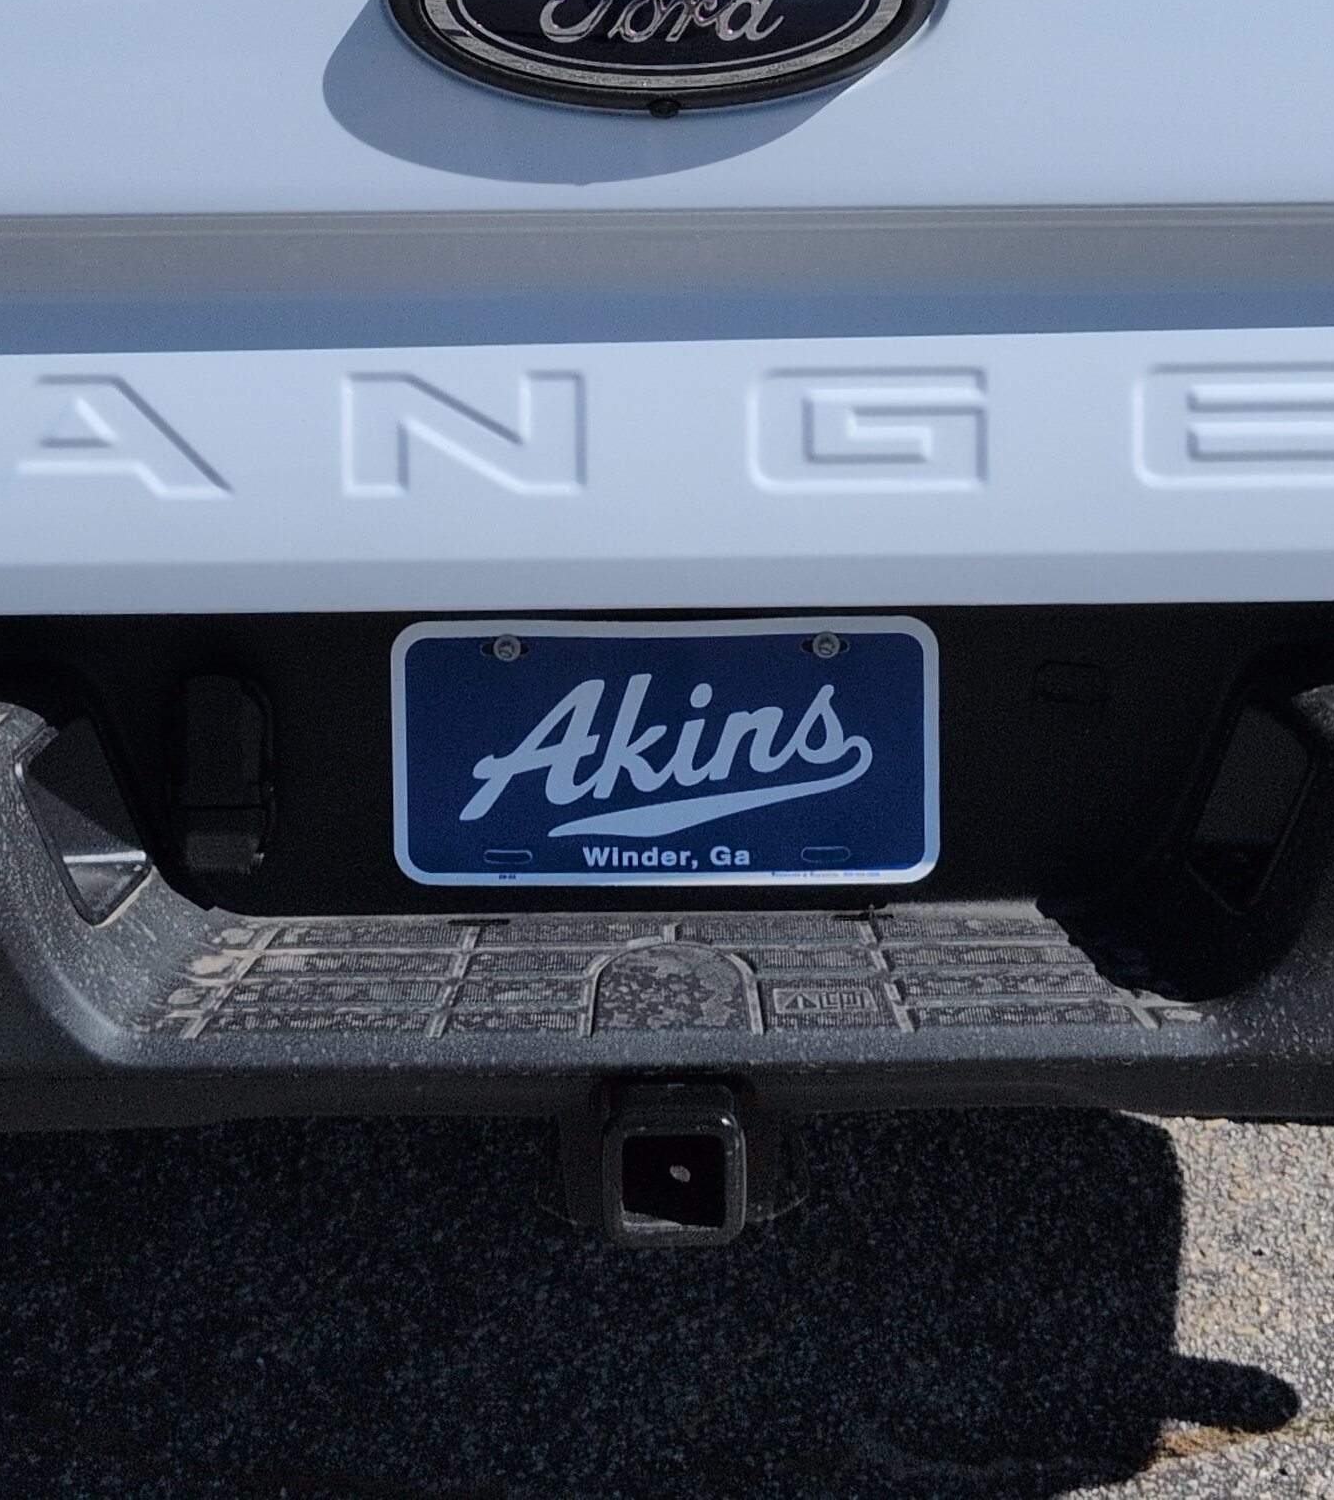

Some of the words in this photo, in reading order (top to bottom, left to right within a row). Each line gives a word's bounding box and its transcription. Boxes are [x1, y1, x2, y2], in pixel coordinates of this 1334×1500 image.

[459, 673, 873, 823] Akins
[582, 846, 698, 870] Winder,
[709, 845, 750, 866] Ga
